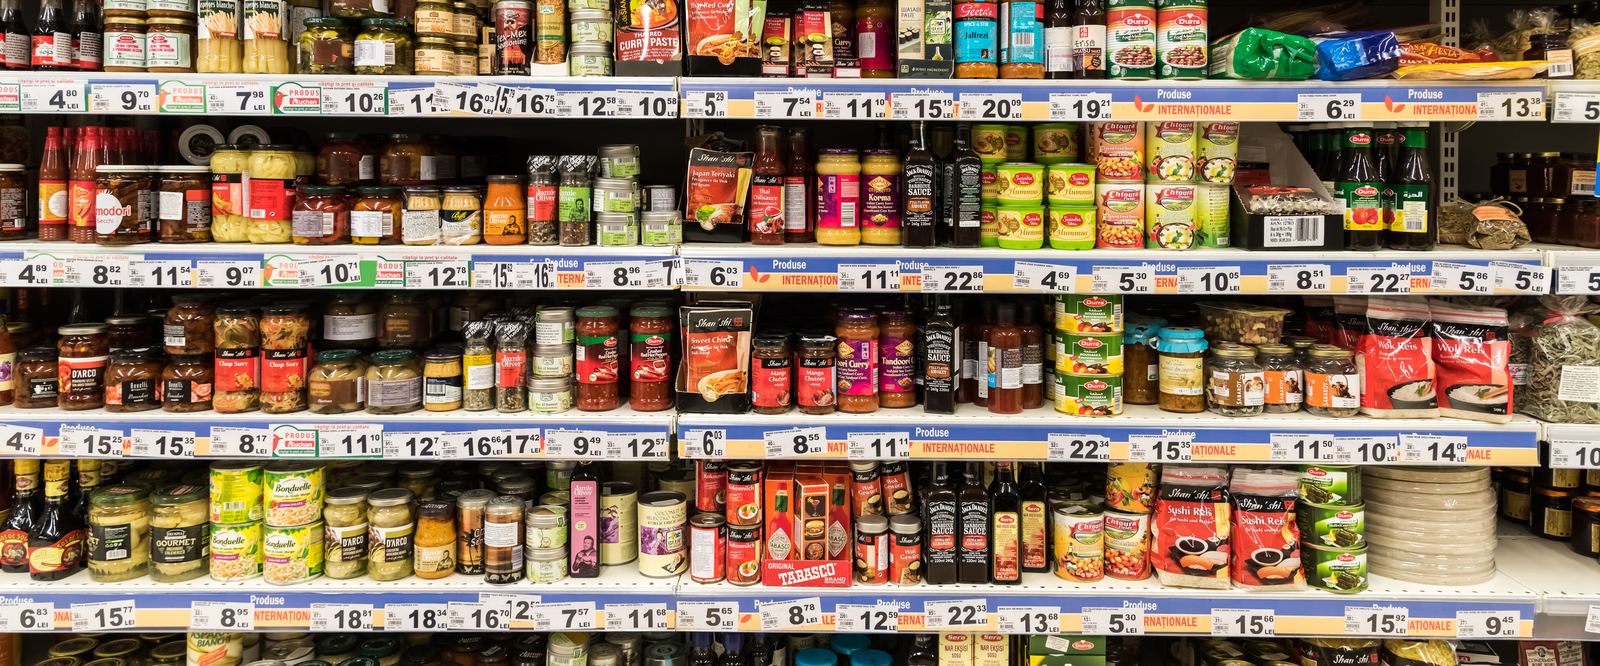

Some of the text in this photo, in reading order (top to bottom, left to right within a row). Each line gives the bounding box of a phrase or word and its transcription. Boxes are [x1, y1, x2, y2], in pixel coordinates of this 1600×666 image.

[961, 3, 993, 17] Geeta's
[1126, 17, 1149, 25] Durra
[1178, 17, 1201, 25] Durra
[498, 30, 527, 44] Tex-Mex
[964, 31, 989, 40] Jalfrezi
[497, 39, 527, 51] Seasoning
[650, 37, 679, 48] PASTE
[834, 38, 852, 47] Curry
[172, 87, 203, 95] PRODUS
[289, 89, 320, 97] PRODUS
[1157, 89, 1191, 100] Produse
[1408, 89, 1443, 100] Produse
[691, 169, 736, 180] Japan Teriyaki
[536, 188, 556, 196] Jamie
[908, 188, 932, 196] SAUCE
[1009, 187, 1039, 196] Hummus
[1109, 189, 1140, 200] Chtoura
[1163, 188, 1193, 199] Chtoura
[868, 193, 891, 202] Korma
[489, 212, 508, 220] Jamie
[1057, 228, 1088, 237] Hummus
[772, 259, 807, 270] Produse
[691, 336, 731, 345] Sweet China
[1080, 340, 1100, 348] Durra
[1377, 339, 1418, 351] Wok Reis
[1463, 344, 1485, 354] Reis
[501, 354, 523, 362] Jamie
[882, 356, 910, 365] Tandoori
[927, 353, 950, 362] SAUCE
[218, 360, 248, 368] Chop Suey
[269, 361, 299, 369] Chop Suey
[501, 360, 522, 368] Oliver
[848, 360, 870, 370] Curry
[770, 370, 786, 378] Mango
[804, 375, 826, 383] Chutney
[1086, 382, 1105, 390] Durra
[915, 427, 949, 438] Produse
[886, 478, 898, 486] Wok
[275, 481, 311, 493] Bonduelle
[1167, 505, 1213, 517] Sushi Reis
[1105, 516, 1138, 528] Chtoura
[1241, 515, 1265, 526] Sushi
[931, 527, 954, 535] SAUCE
[963, 527, 986, 535] SAUCE
[156, 537, 196, 547] GOURMET
[213, 536, 245, 547] Bonduelle
[266, 539, 296, 550] Bonduelle
[767, 562, 795, 570] ORIGINAL
[778, 564, 836, 586] TABASCO
[197, 637, 232, 648] BIANCHI
[1073, 642, 1094, 650] Durra
[944, 644, 954, 652] NAR
